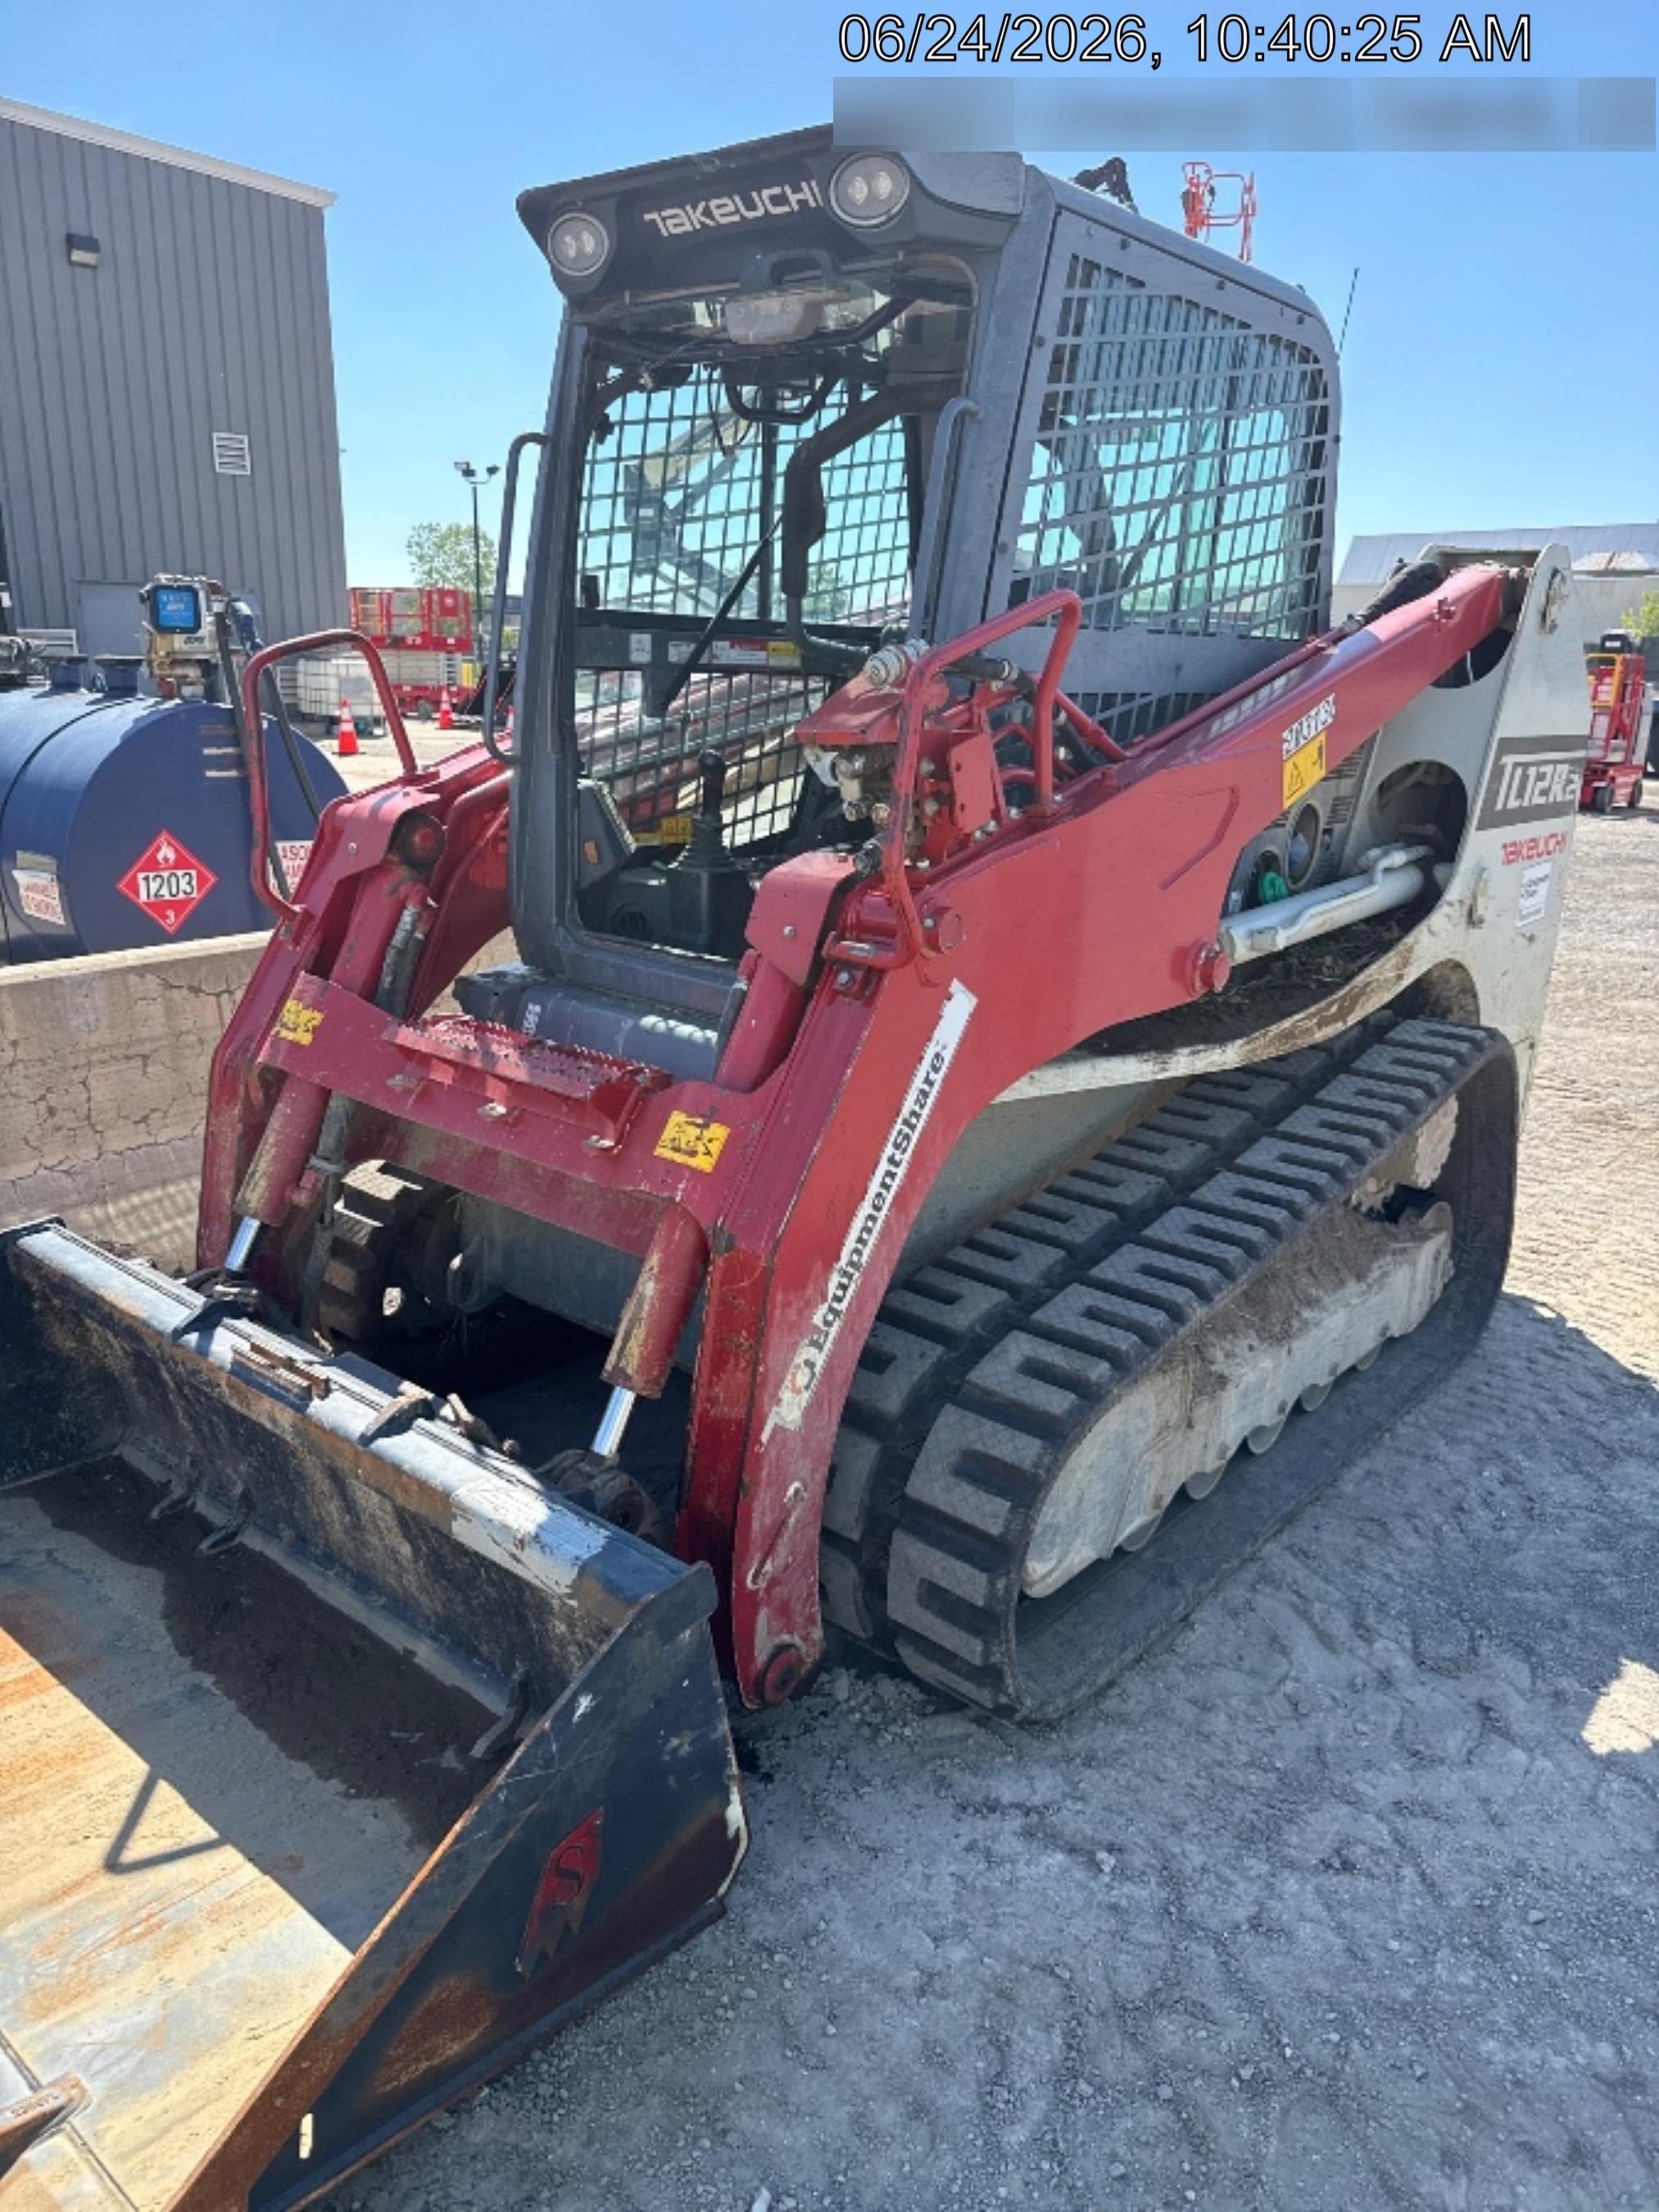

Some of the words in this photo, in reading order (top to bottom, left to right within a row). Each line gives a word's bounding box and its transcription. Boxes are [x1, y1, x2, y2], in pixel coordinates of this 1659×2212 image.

[142, 872, 195, 900] 1203
[165, 909, 176, 926] 3
[808, 1050, 947, 1352] EquipmentShare
